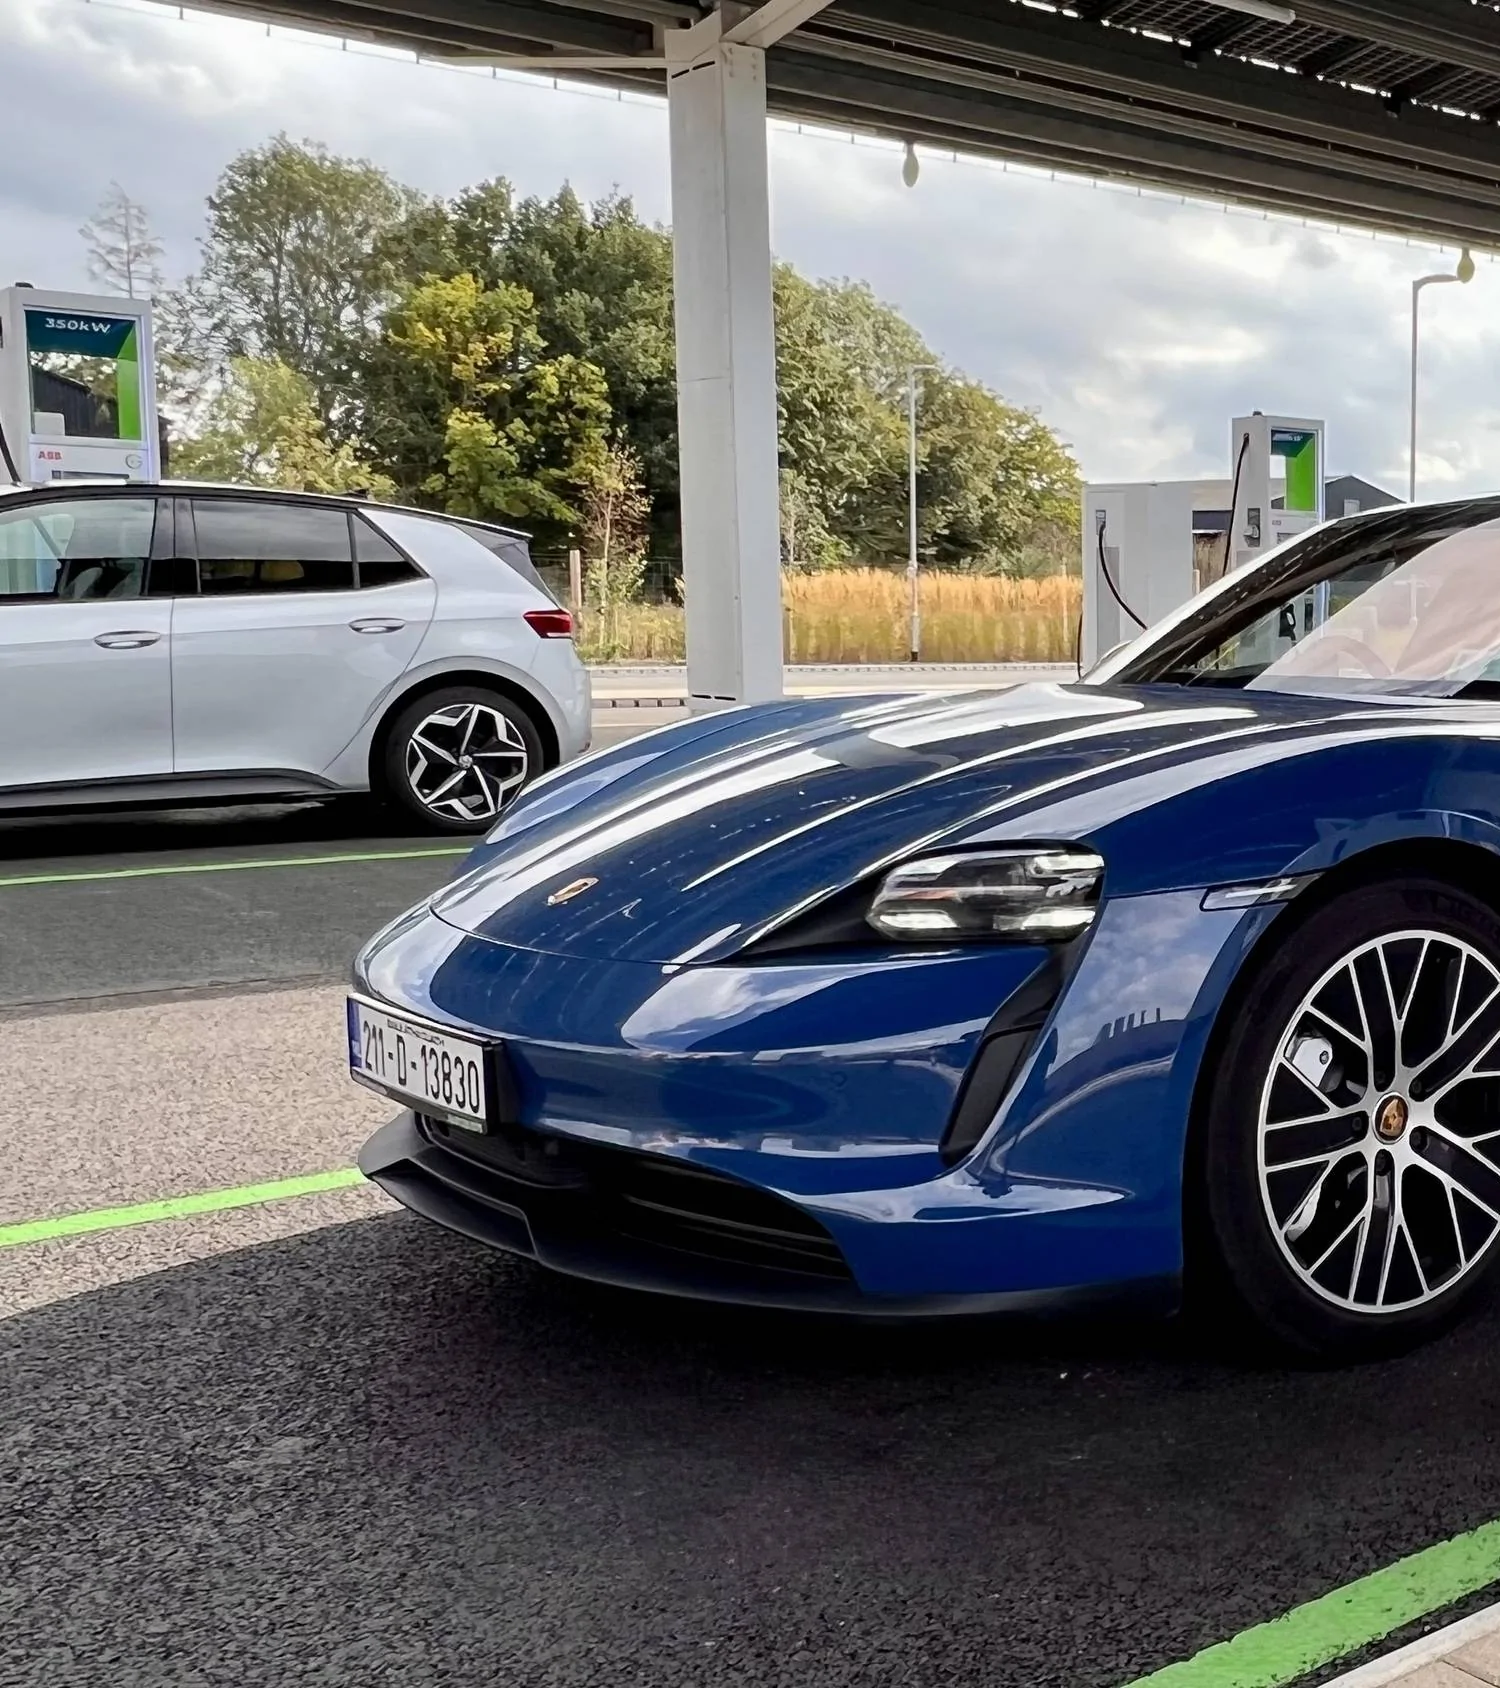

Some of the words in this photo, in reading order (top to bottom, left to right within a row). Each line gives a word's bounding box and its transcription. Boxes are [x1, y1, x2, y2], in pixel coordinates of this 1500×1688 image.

[45, 317, 112, 334] 350kW
[38, 450, 62, 460] ABB
[363, 1020, 480, 1114] 211-D-13830
